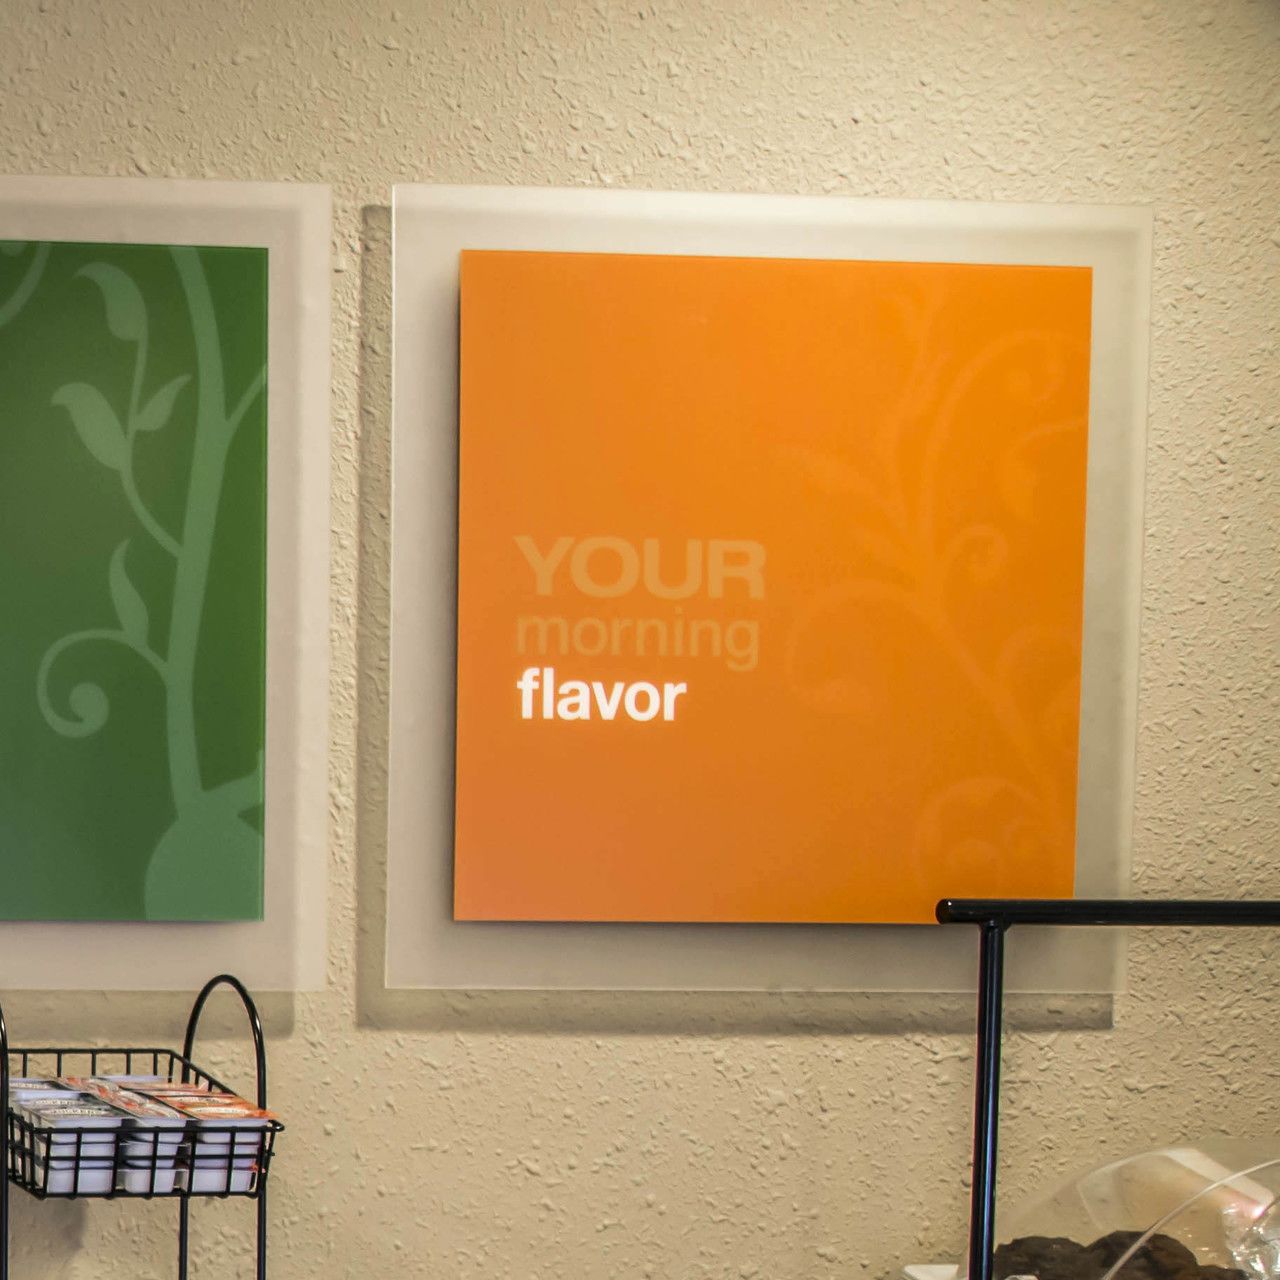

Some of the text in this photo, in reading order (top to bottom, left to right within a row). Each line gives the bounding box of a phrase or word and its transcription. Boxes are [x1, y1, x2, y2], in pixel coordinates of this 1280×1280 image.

[512, 535, 767, 600] YOUR
[515, 606, 759, 672] morning
[516, 667, 687, 721] flavor
